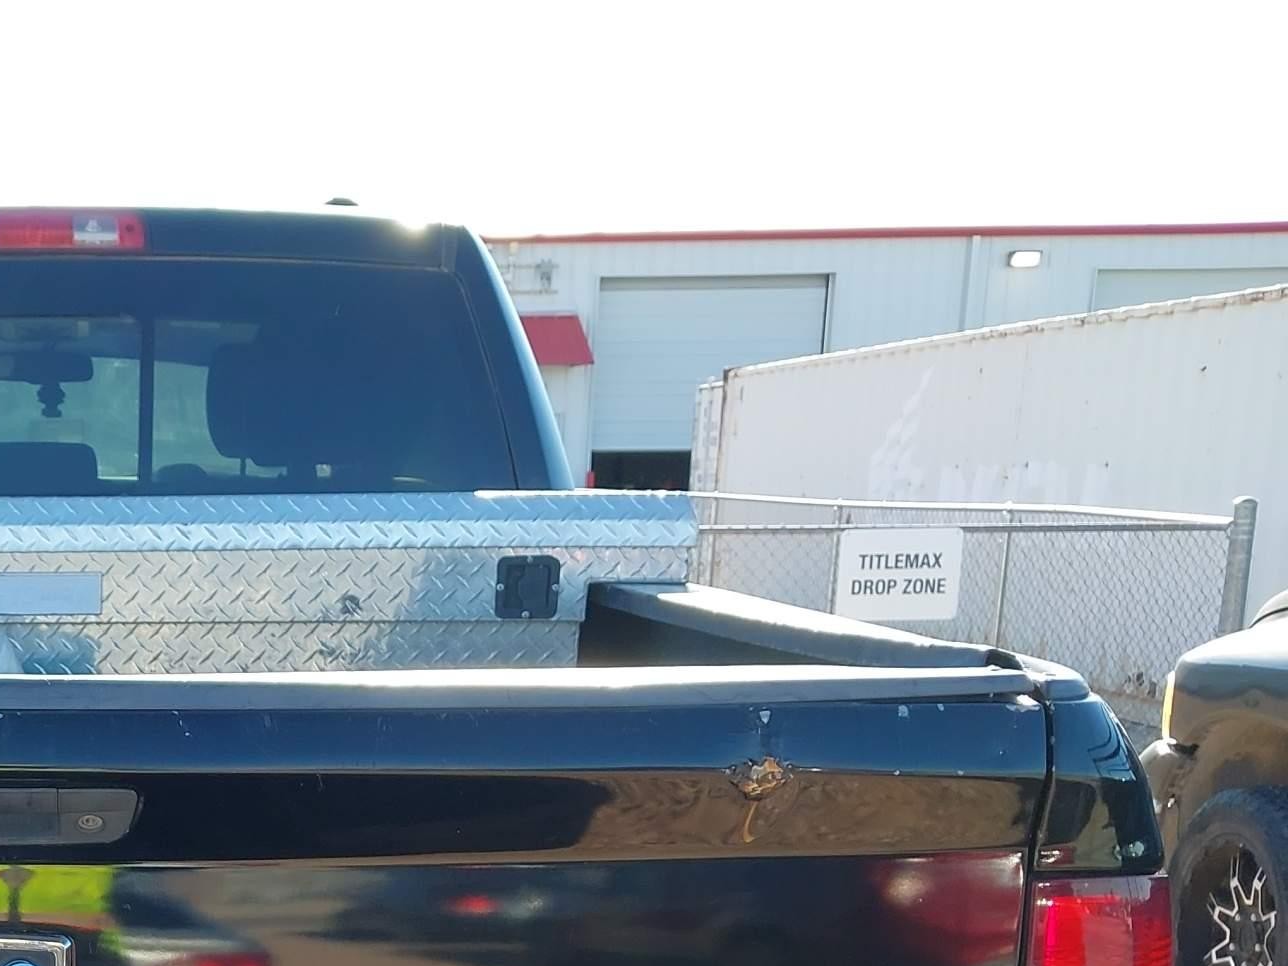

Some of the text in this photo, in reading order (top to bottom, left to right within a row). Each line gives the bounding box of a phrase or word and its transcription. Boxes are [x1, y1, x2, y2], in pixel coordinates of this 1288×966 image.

[859, 552, 943, 570] TITLEMAX
[851, 578, 947, 595] DROP ZONE
